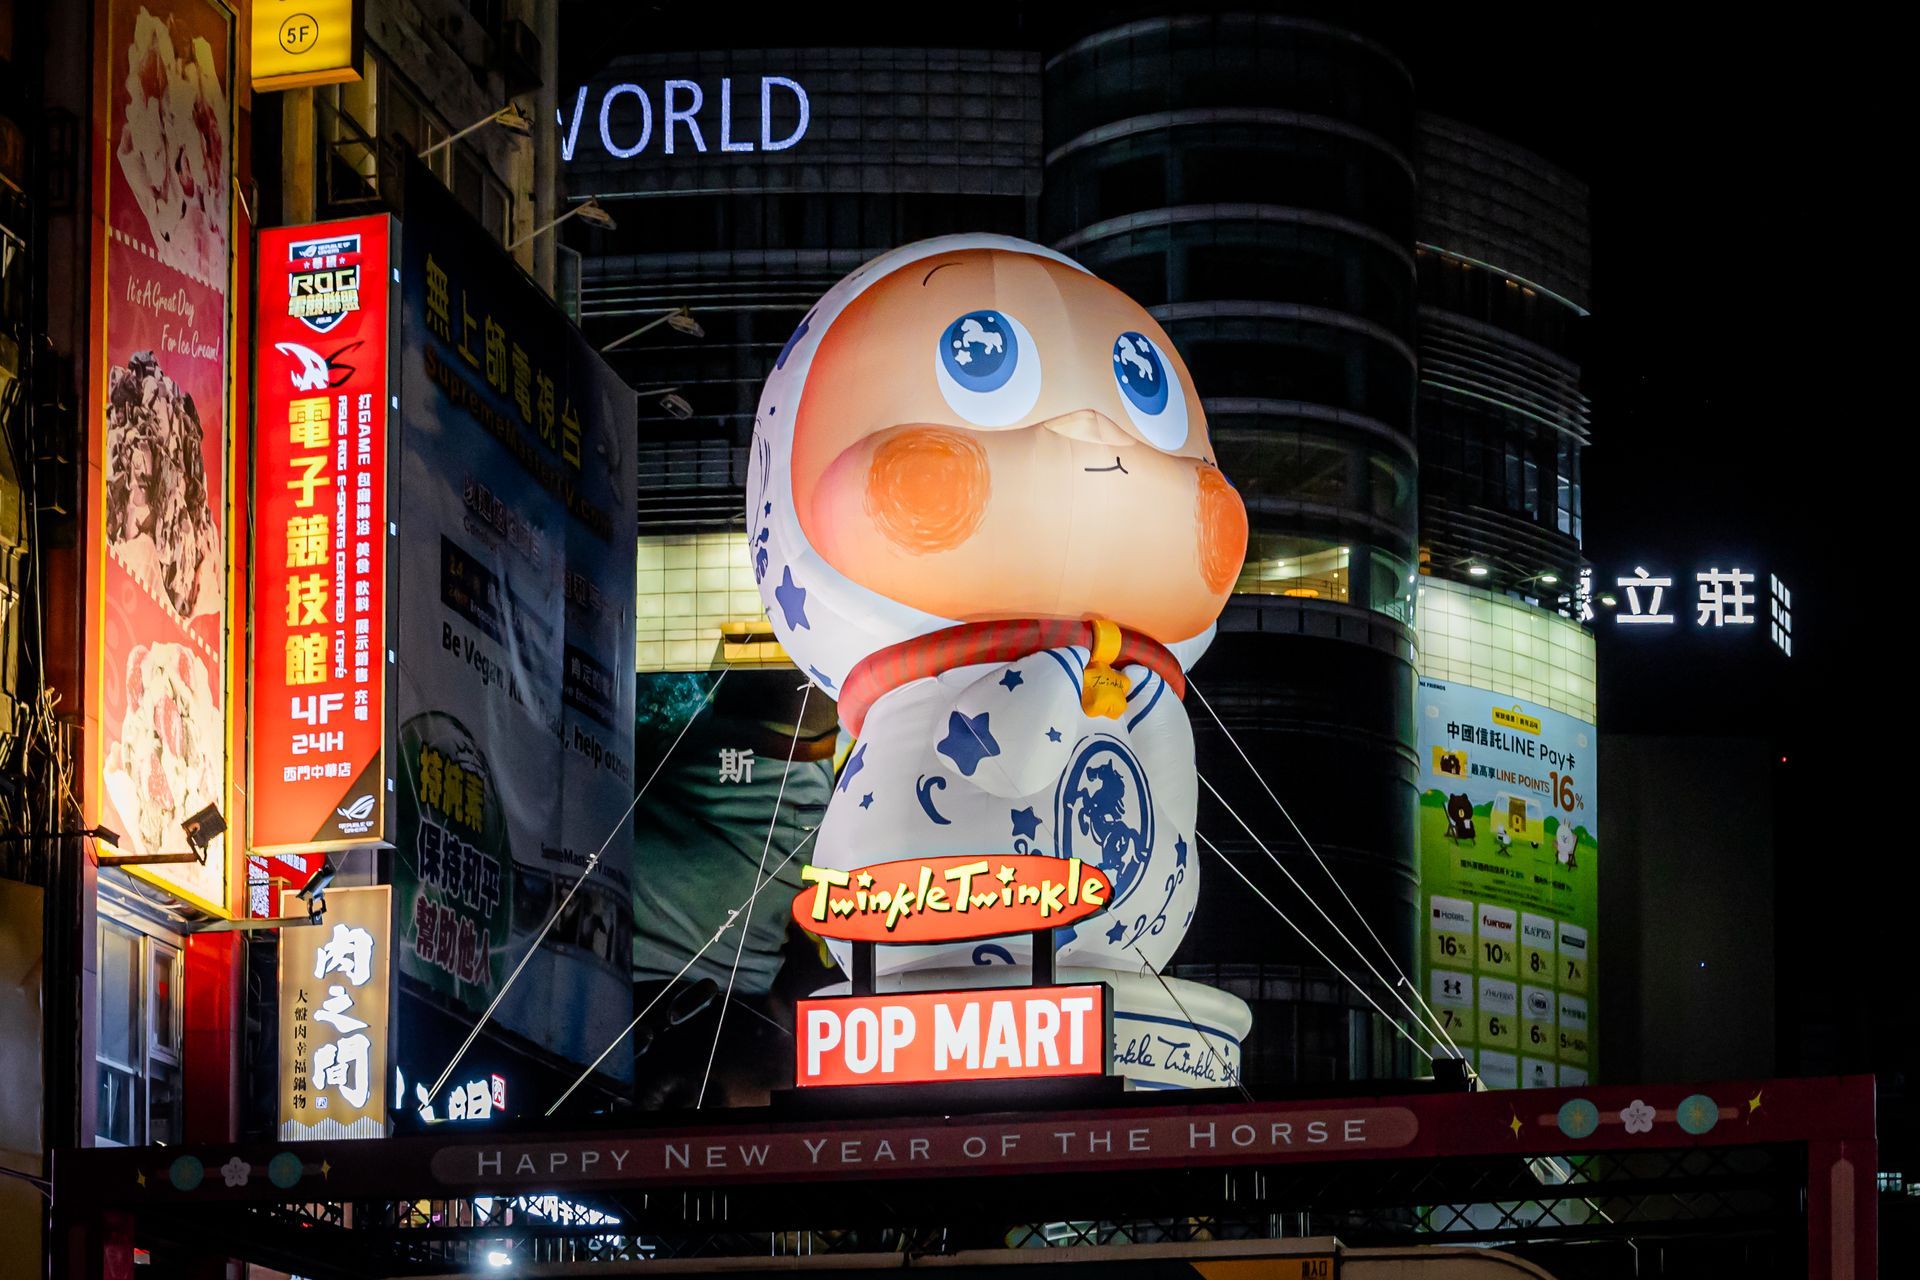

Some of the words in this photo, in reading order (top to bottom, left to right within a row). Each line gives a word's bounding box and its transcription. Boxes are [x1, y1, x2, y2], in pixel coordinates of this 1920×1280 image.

[287, 26, 309, 44] 5F
[291, 269, 357, 296] ROG
[142, 280, 152, 308] A
[152, 282, 177, 317] Great
[178, 288, 194, 327] Day
[161, 324, 176, 352] For
[178, 328, 190, 355] Ice
[191, 330, 220, 362] Cream!
[286, 396, 331, 686] 電子競技館
[442, 621, 460, 657] Be
[291, 693, 344, 726] 4F
[291, 731, 344, 755] 24H
[574, 725, 602, 769] help
[1540, 743, 1576, 771] Pay卡
[283, 762, 351, 783] 西門中華店
[719, 748, 755, 783] 斯
[1518, 774, 1550, 794] POINTS
[417, 819, 500, 918] 保持和平
[415, 895, 492, 986] 幫助他人
[807, 1005, 916, 1076] POP
[933, 997, 1093, 1071] MART
[1157, 1035, 1216, 1083] Twinkle
[477, 1149, 630, 1176] HAPPY
[664, 1142, 771, 1169] NEW
[803, 1137, 930, 1164] YEAR
[963, 1134, 1021, 1158] OF
[1054, 1128, 1151, 1153] THE
[1189, 1118, 1367, 1149] HORSE
